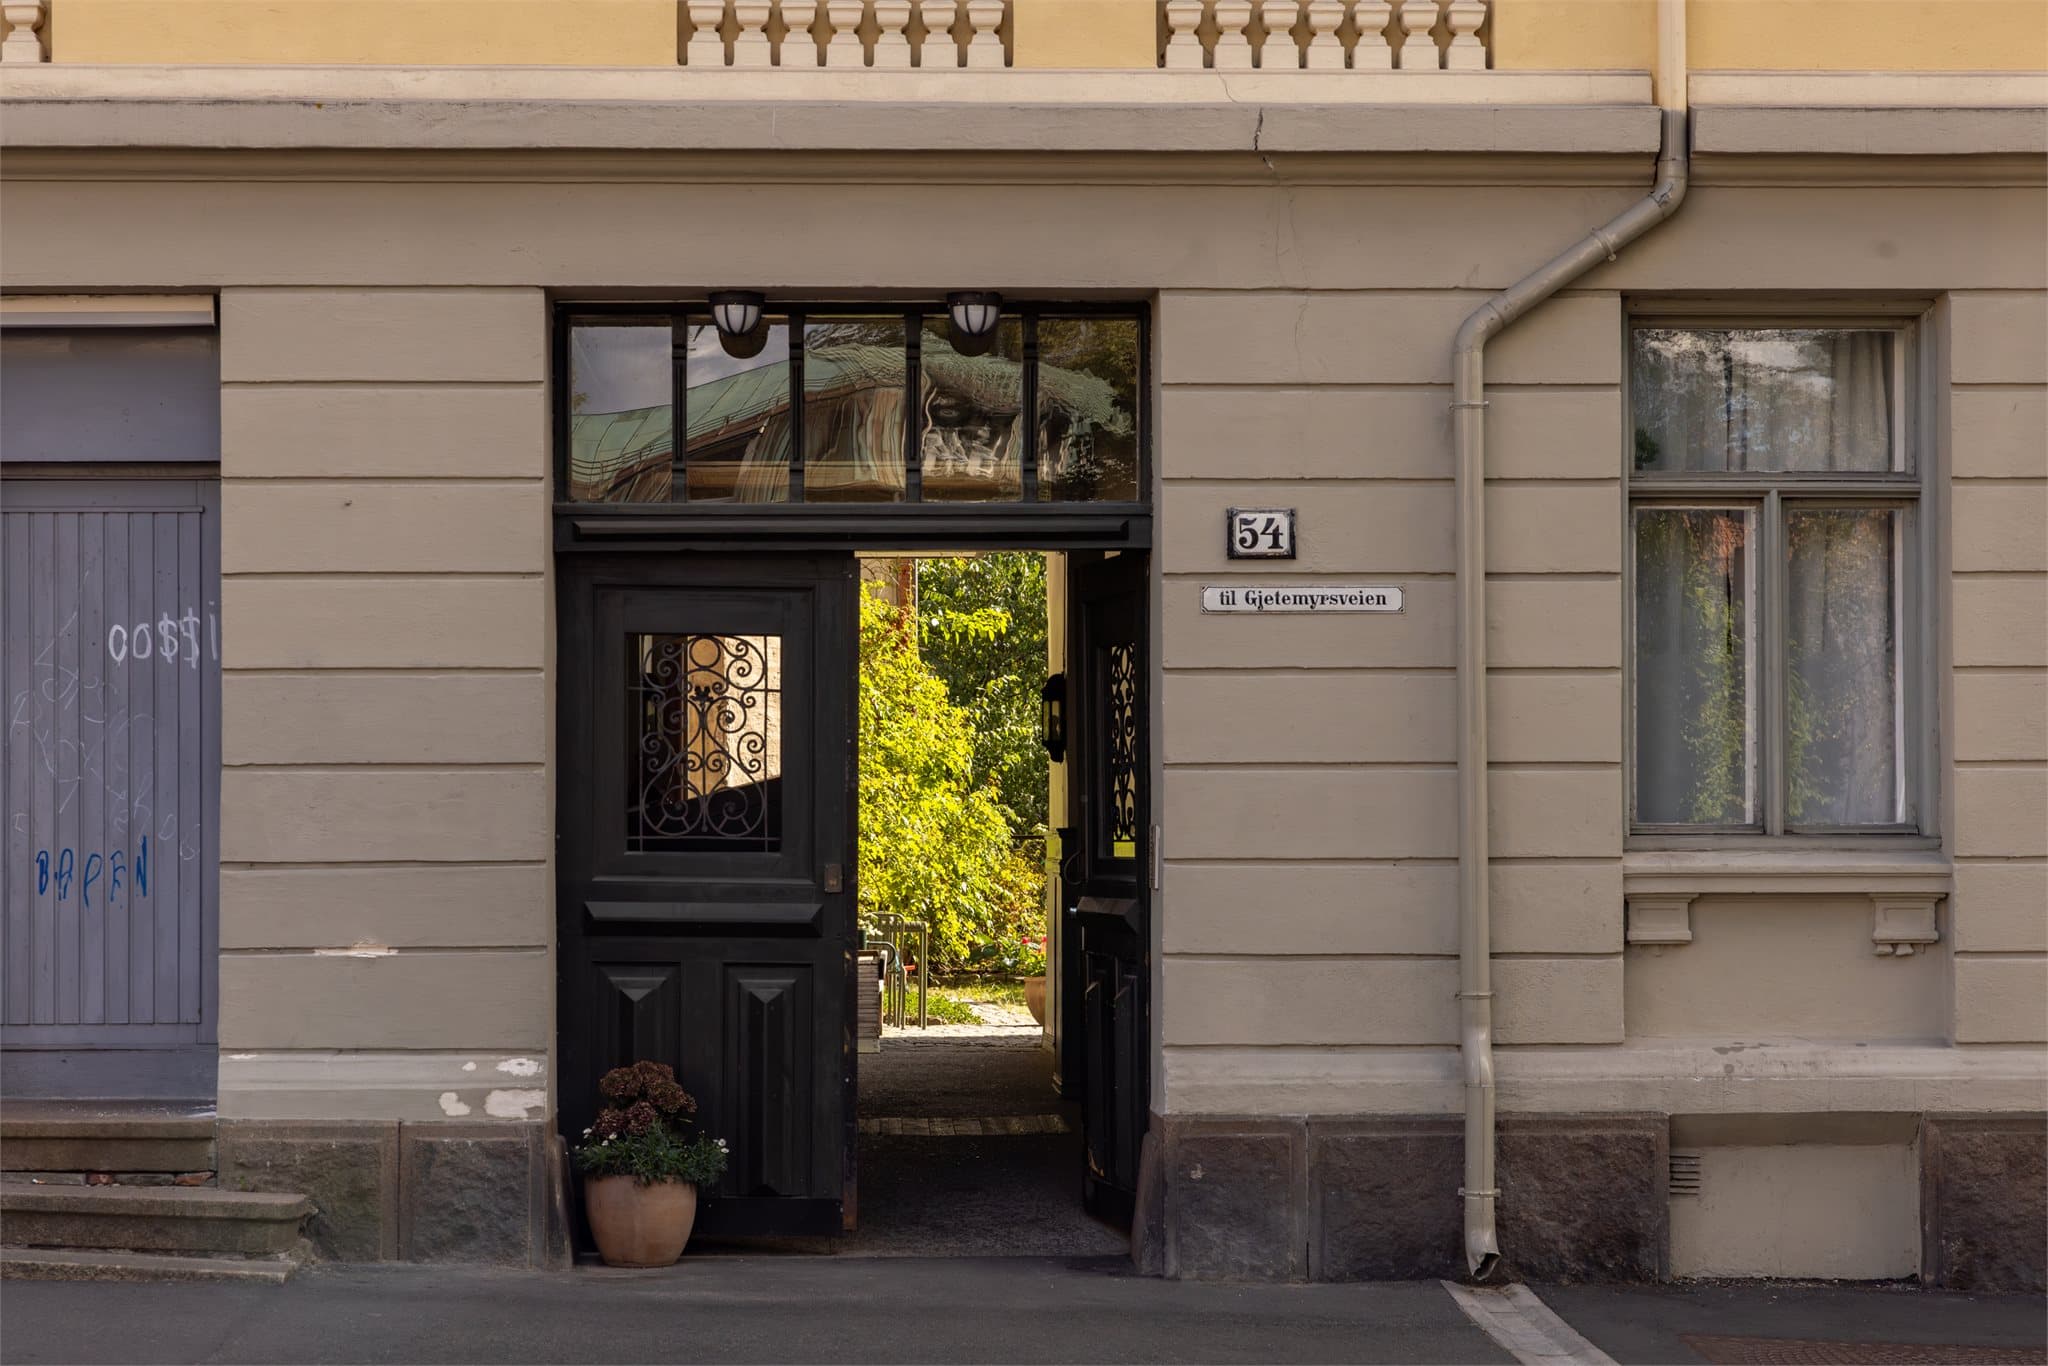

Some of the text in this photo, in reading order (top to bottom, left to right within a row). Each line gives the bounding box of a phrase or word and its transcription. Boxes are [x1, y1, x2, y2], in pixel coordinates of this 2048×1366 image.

[1238, 517, 1284, 550] 54
[1219, 590, 1387, 611] til Gjetemyrsveien
